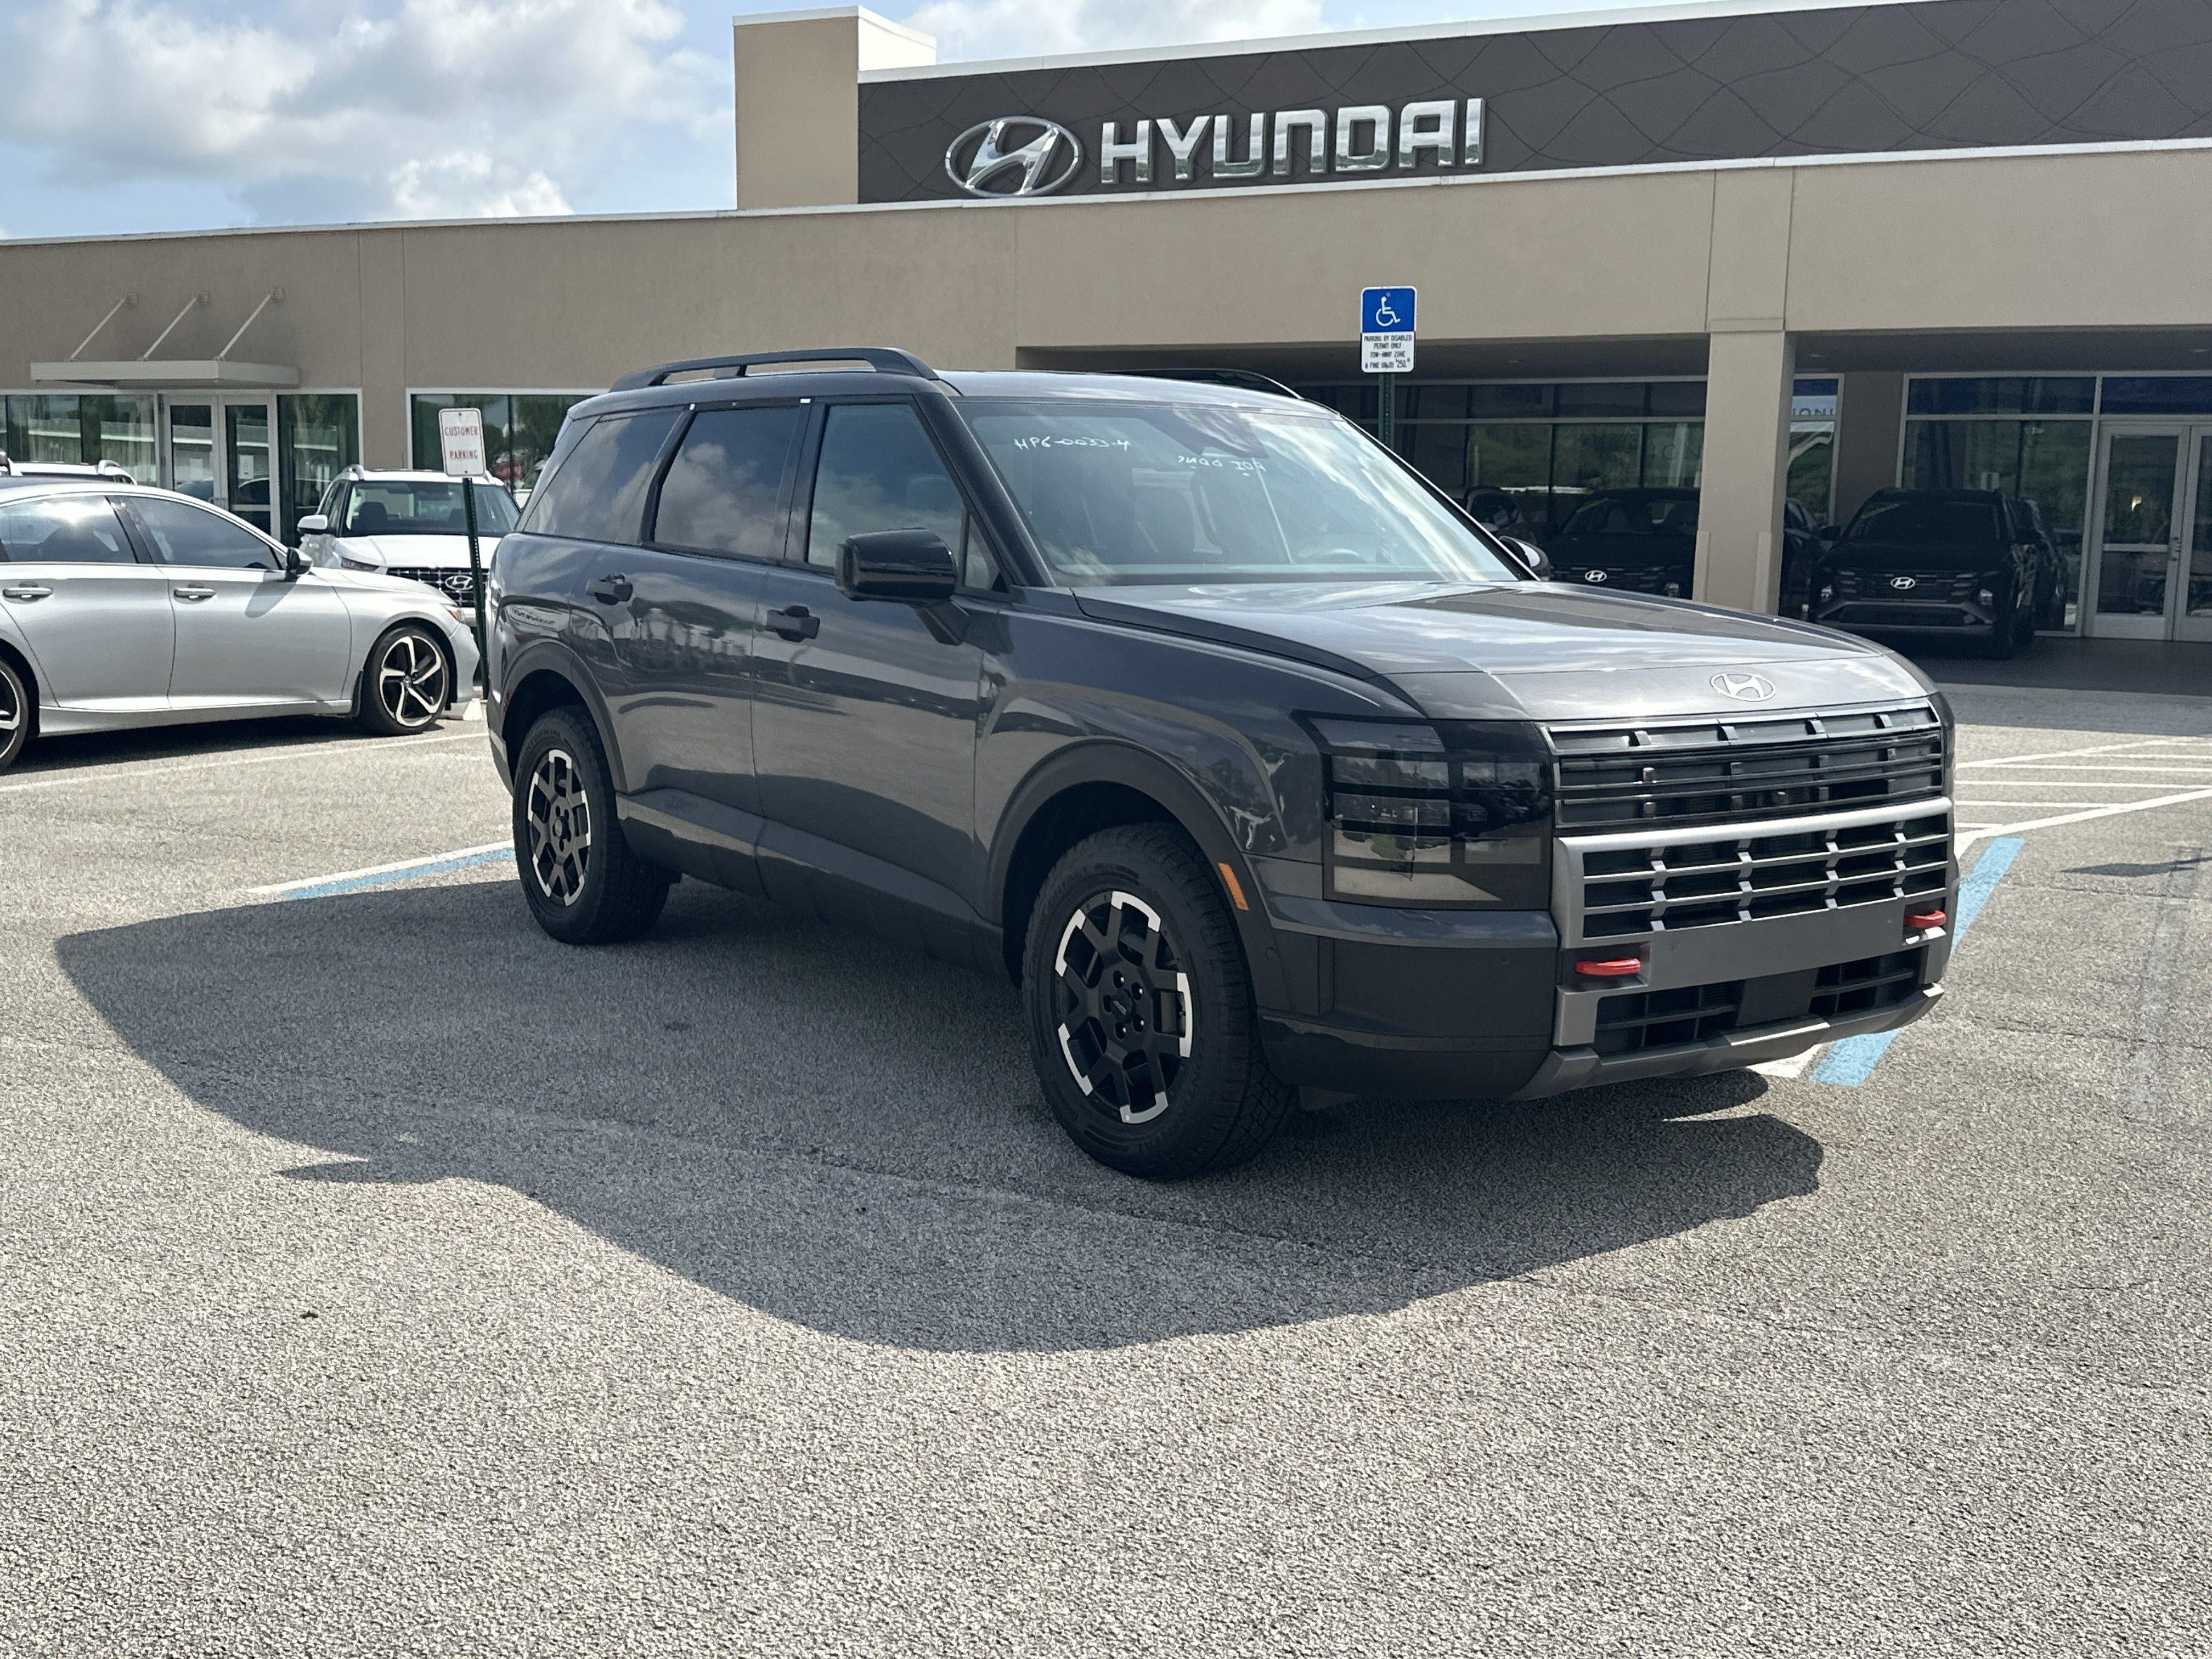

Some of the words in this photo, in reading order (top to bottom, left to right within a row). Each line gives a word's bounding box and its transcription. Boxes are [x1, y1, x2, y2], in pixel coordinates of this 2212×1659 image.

[1102, 98, 1485, 184] HYUNDAI
[444, 426, 478, 437] CUSTOMER
[449, 450, 478, 460] PARKING
